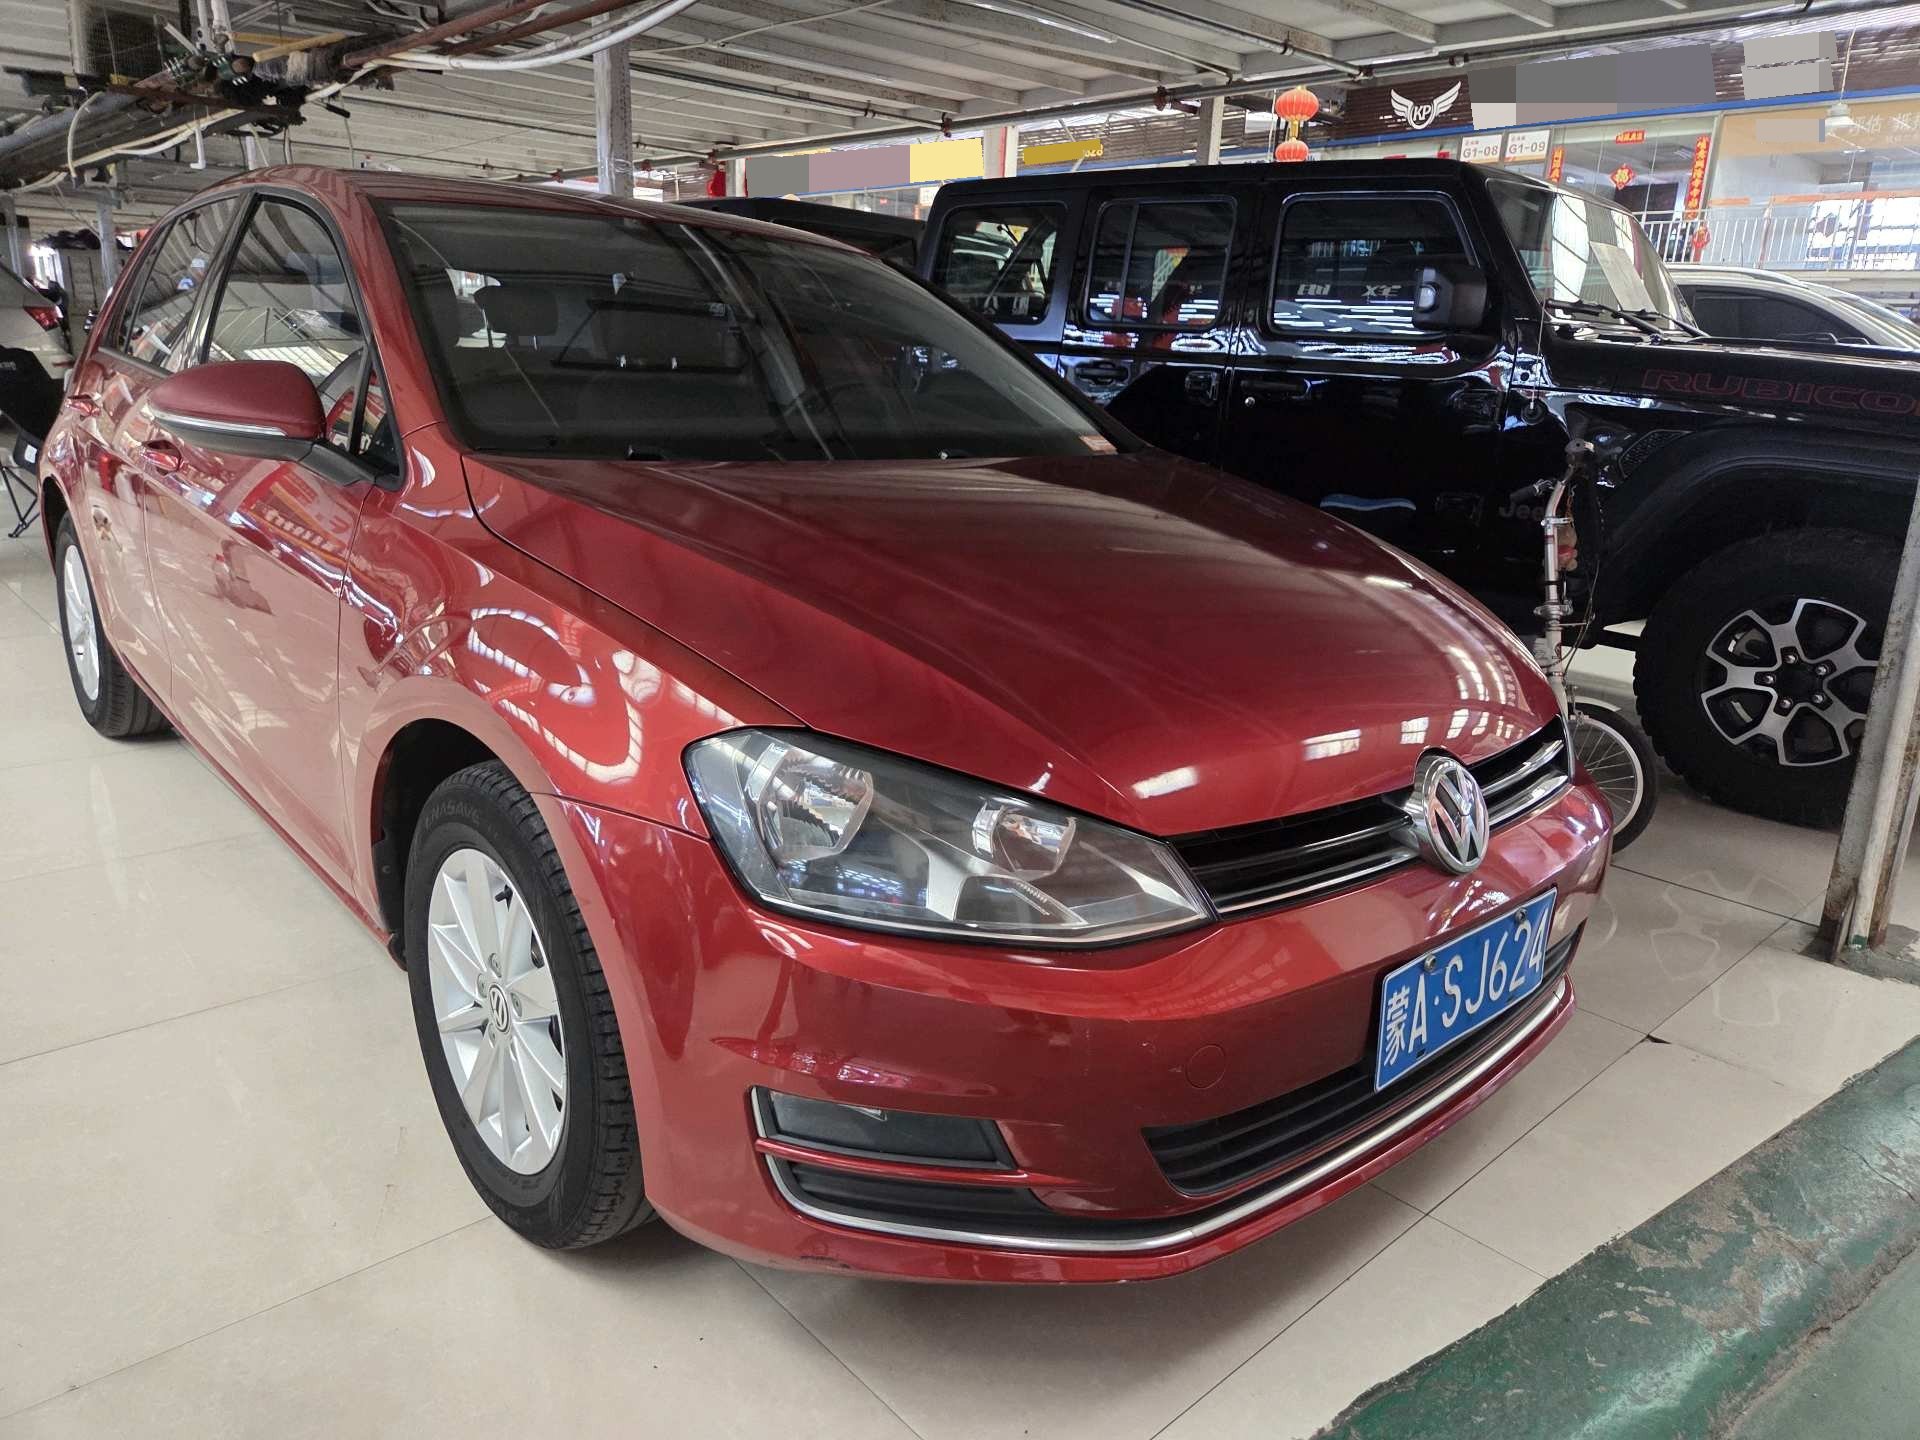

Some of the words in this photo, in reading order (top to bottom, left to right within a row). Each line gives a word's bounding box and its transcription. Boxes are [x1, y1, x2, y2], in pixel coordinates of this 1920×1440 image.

[1413, 104, 1432, 122] KP
[1463, 145, 1499, 159] G1-08
[1509, 141, 1546, 155] G1-09
[1641, 368, 1920, 416] RUBICO
[1499, 500, 1545, 522] Jee
